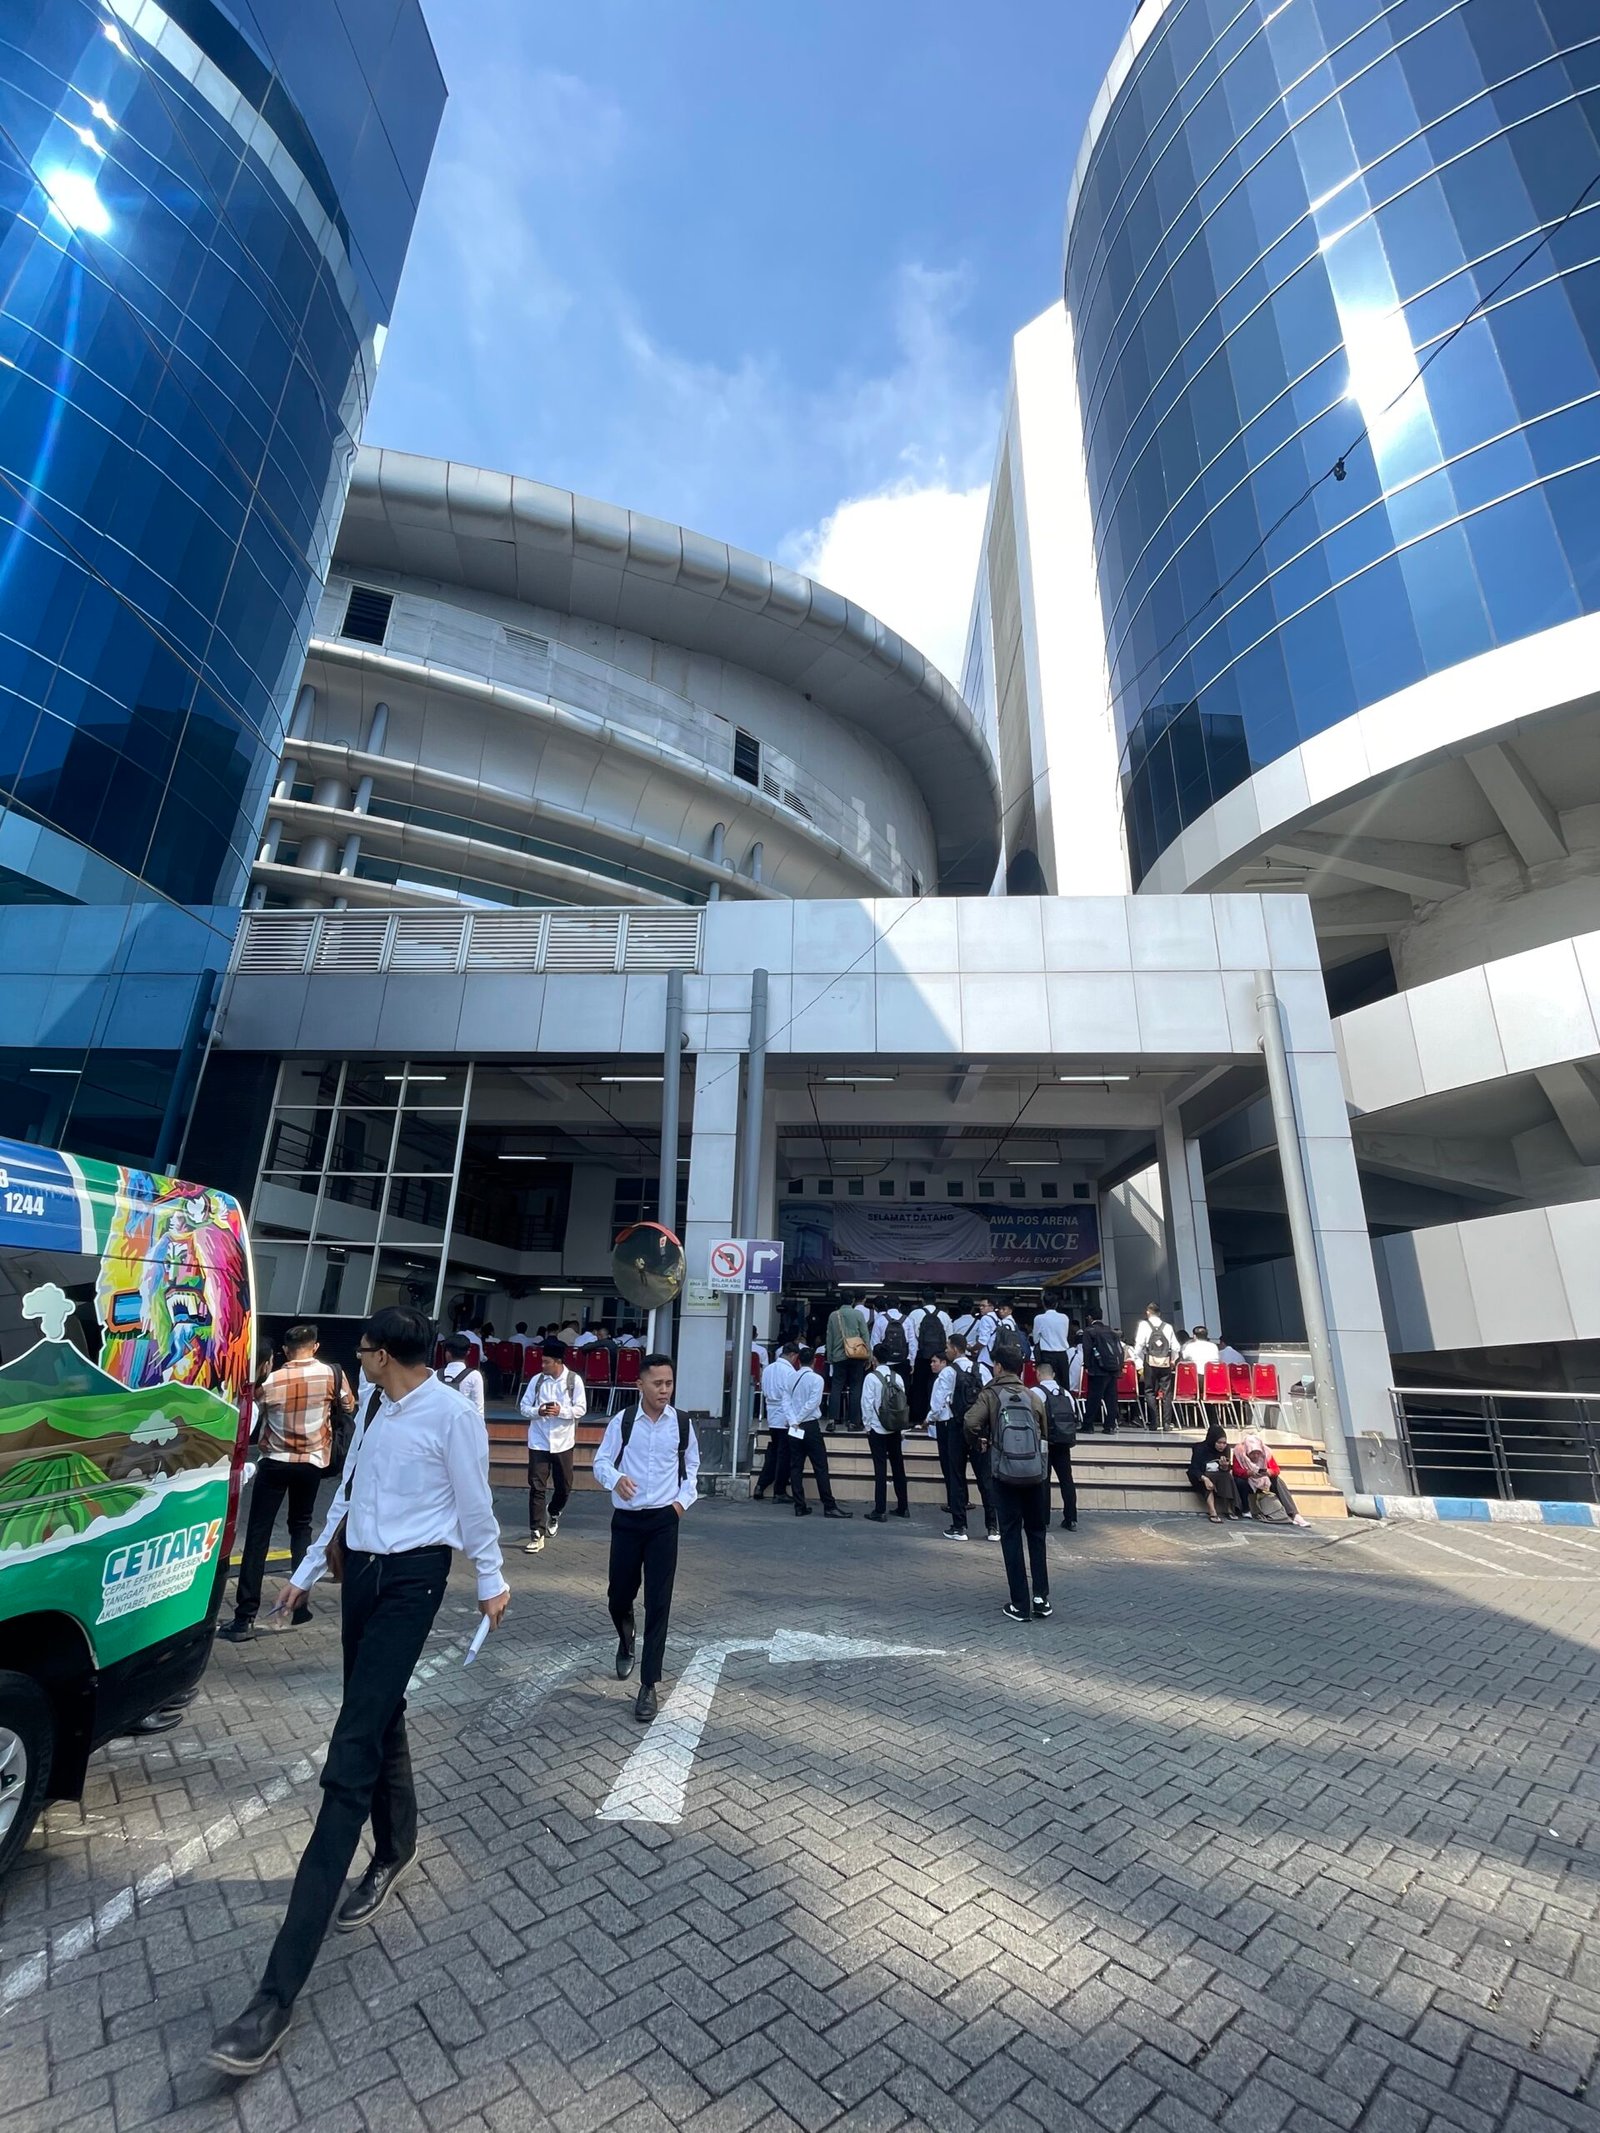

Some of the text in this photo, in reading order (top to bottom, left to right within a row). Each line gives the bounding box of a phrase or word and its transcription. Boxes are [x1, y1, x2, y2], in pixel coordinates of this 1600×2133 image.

[4, 1192, 45, 1216] 1244
[867, 1213, 955, 1222] SELAMAT DATANG
[989, 1215, 1079, 1226] AWA POS ARENA
[1013, 1256, 1032, 1264] ALL
[1033, 1256, 1072, 1265] EVENT
[133, 1568, 166, 1587] EFEKTIF
[146, 1568, 196, 1593] TRANSPARAN
